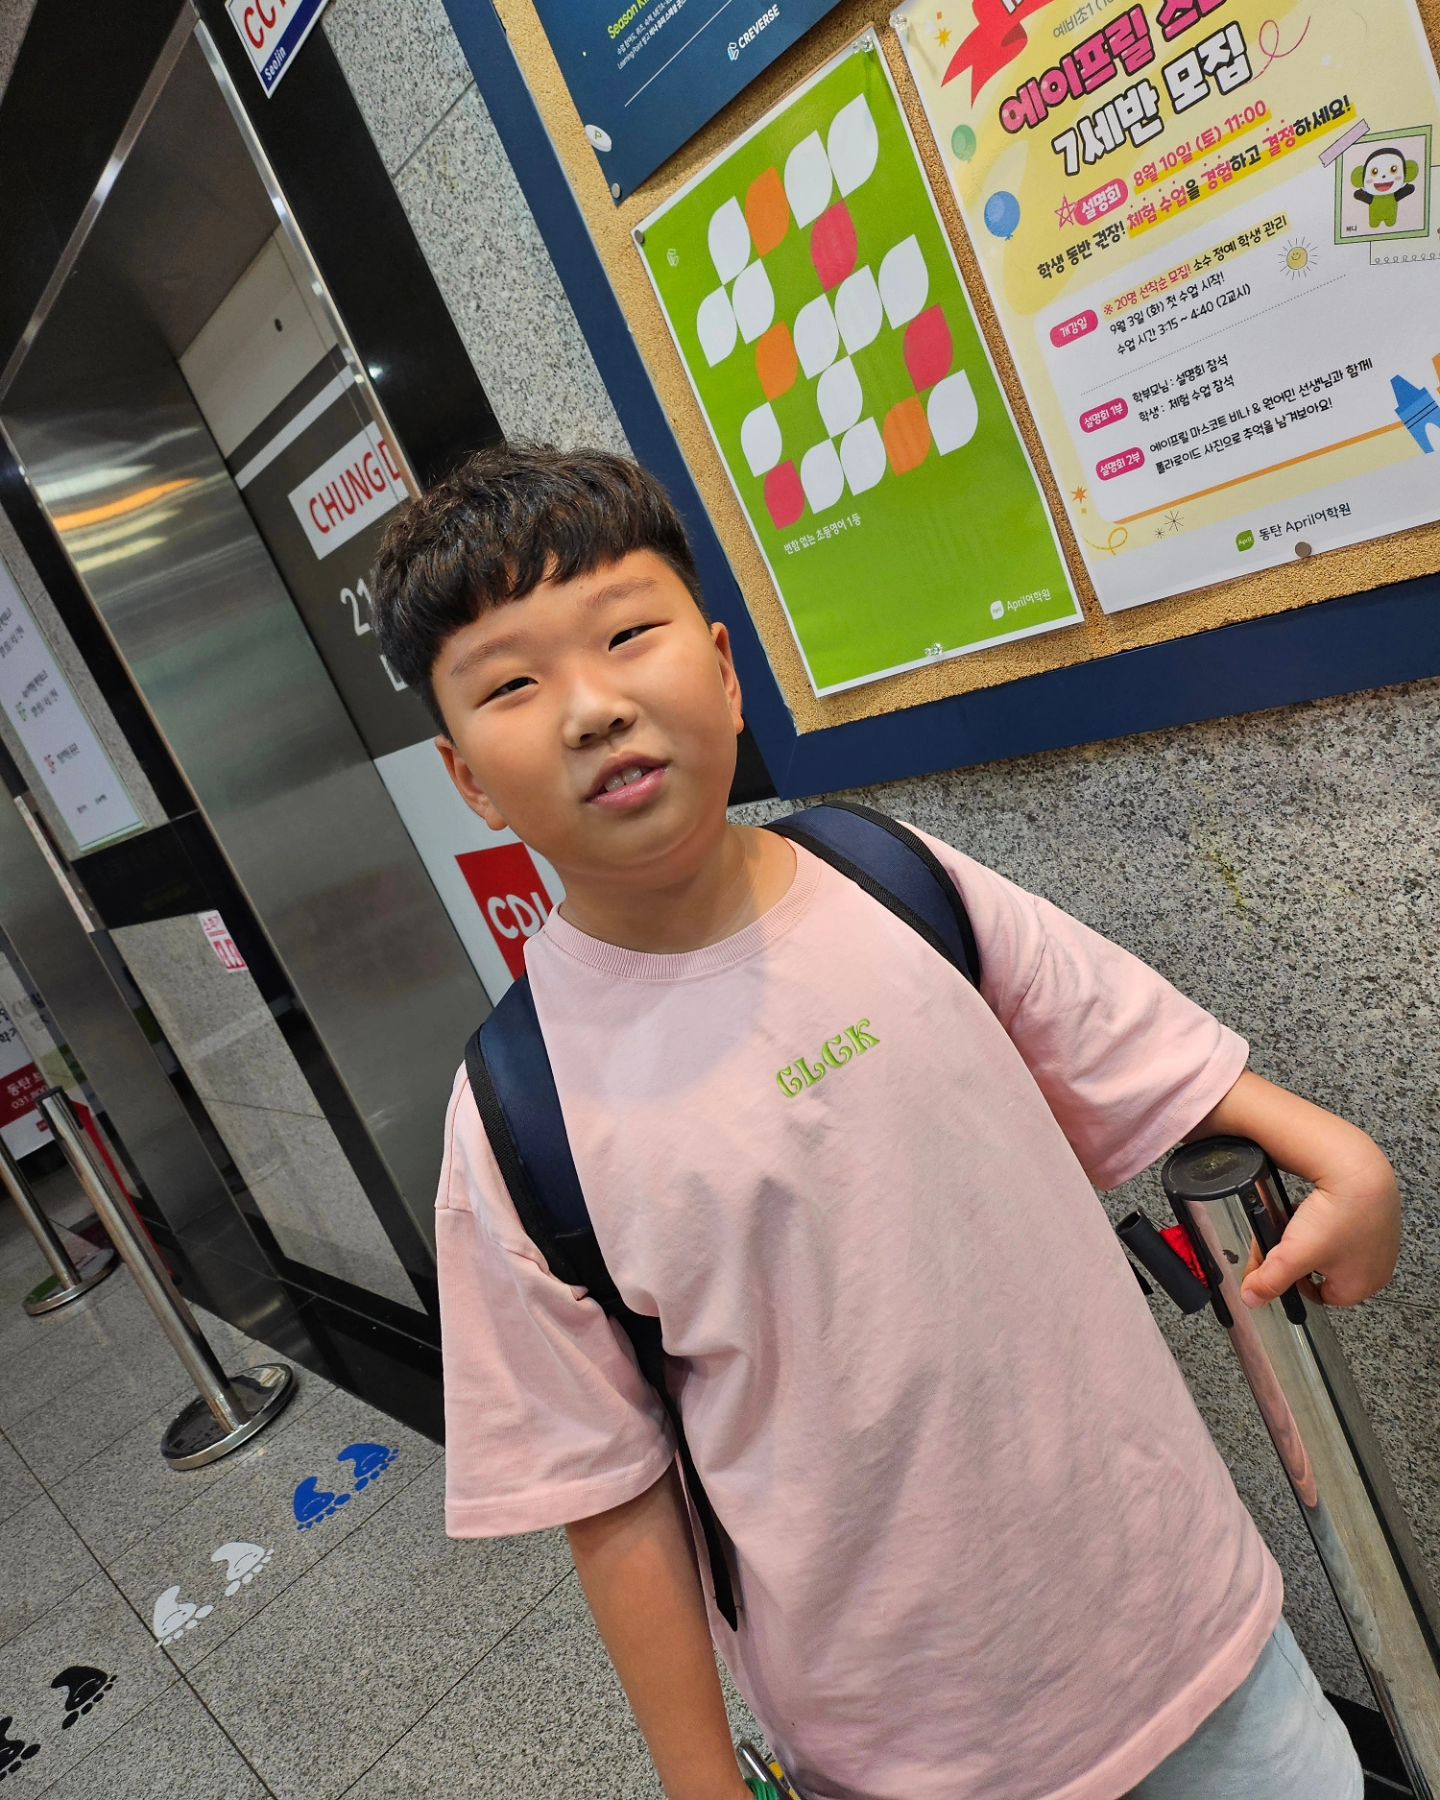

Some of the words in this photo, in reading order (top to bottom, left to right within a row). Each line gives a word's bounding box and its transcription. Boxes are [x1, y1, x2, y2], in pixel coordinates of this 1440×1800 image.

[244, 0, 286, 49] CC
[607, 4, 639, 39] Season
[738, 3, 780, 48] CREVERSE
[265, 46, 287, 80] Seojin
[1000, 3, 1156, 134] 에이프릴
[1051, 78, 1165, 176] 7세반
[1161, 20, 1253, 114] 모집
[1081, 183, 1122, 220] 설명회
[1133, 162, 1159, 187] 8월
[1159, 142, 1193, 171] 10일
[1195, 126, 1222, 153] (토)
[1224, 100, 1267, 134] 11:00
[1037, 253, 1065, 280] 학생
[1066, 240, 1093, 266] 동반
[1093, 221, 1126, 250] 권장!
[1126, 203, 1158, 231] 체험
[1159, 179, 1201, 213] 수업을
[1201, 145, 1262, 190] 경험하고
[1262, 95, 1352, 158] 결정하세요!
[1114, 291, 1138, 310] 20명
[1139, 276, 1168, 300] 선착순
[1168, 263, 1191, 283] 모집!
[1193, 254, 1212, 271] 소수
[1212, 240, 1237, 261] 정예
[1237, 227, 1261, 247] 학생
[1262, 215, 1287, 237] 관리
[1059, 316, 1088, 337] 개강일
[1110, 319, 1127, 335] 9월
[1127, 310, 1145, 327] 3일
[1146, 301, 1164, 318] (화)
[1166, 294, 1178, 309] 첫
[1179, 284, 1199, 302] 수업
[1201, 271, 1225, 291] 시작!
[1117, 338, 1136, 355] 수업
[1137, 328, 1157, 345] 시간
[1158, 318, 1179, 336] 3:15
[1191, 301, 1214, 320] 4:40
[1216, 283, 1251, 308] (2교시)
[1132, 380, 1169, 404] 학부모님
[1175, 364, 1206, 386] 설명회
[1205, 353, 1229, 373] 참석
[1138, 405, 1160, 423] 학생
[1168, 393, 1190, 411] 체험
[1191, 384, 1211, 401] 수업
[1212, 374, 1235, 393] 참석
[1084, 409, 1109, 429] 설명회
[1110, 403, 1124, 416] 1부
[1149, 430, 1189, 453] 에이프릴
[1190, 415, 1228, 439] 마스코트
[1228, 406, 1250, 423] 비나
[1262, 388, 1297, 411] 원어민
[1298, 369, 1344, 397] 선생님과
[1345, 357, 1373, 379] 함께
[1155, 447, 1201, 475] 폴라로이드
[1204, 431, 1242, 455] 사진으로
[1242, 419, 1275, 440] 추억을
[1274, 397, 1334, 429] 남겨보아요!
[1100, 456, 1125, 477] 설명회
[1126, 451, 1141, 466] 2부
[783, 539, 800, 555] 변함
[816, 518, 848, 541] 초등영어
[847, 512, 861, 527] 1등
[1259, 524, 1282, 541] 동탄
[1285, 502, 1352, 532] April어학원
[1007, 589, 1051, 611] April어학원
